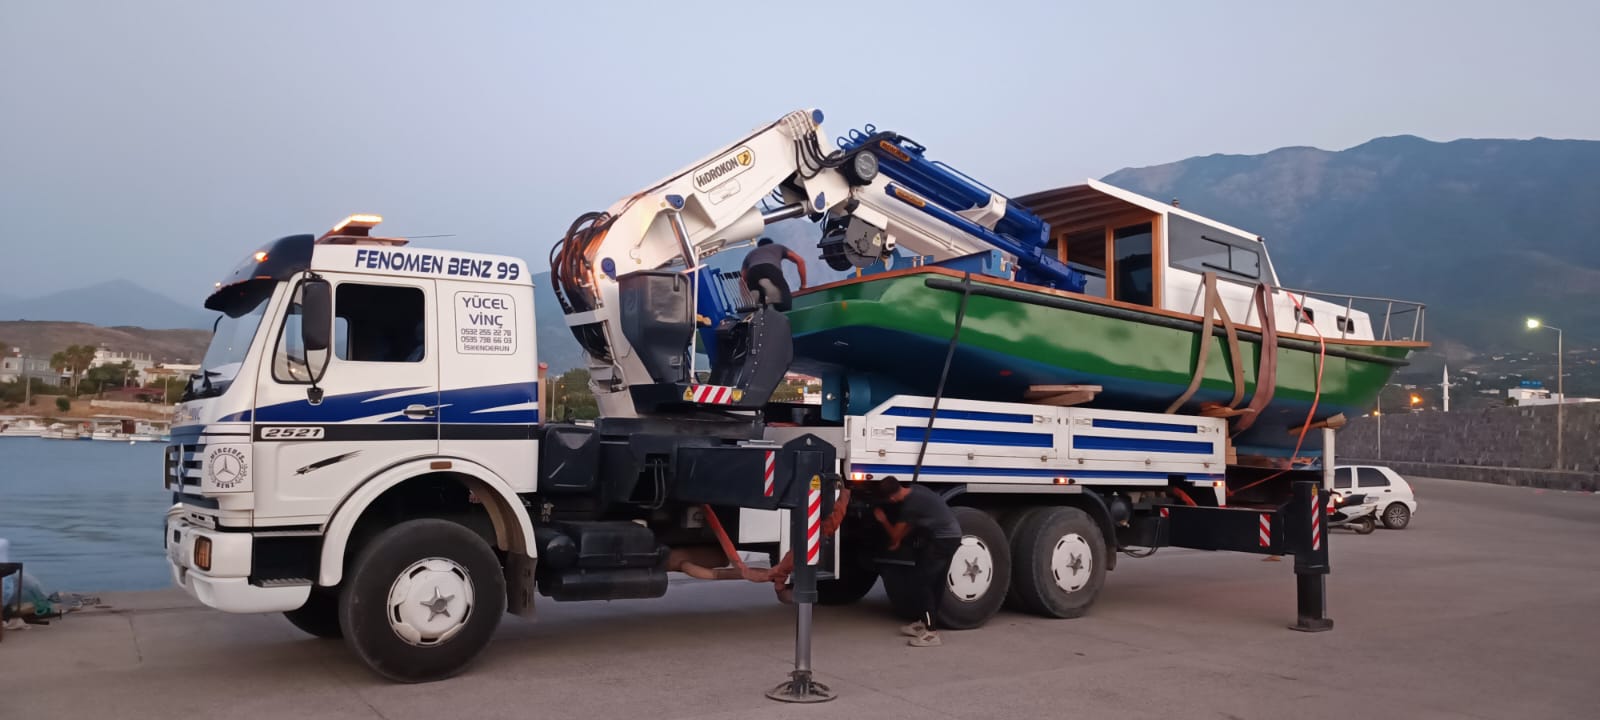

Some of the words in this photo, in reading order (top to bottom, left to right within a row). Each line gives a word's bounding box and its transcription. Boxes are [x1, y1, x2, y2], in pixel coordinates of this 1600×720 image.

[355, 249, 444, 274] FENOMEN
[447, 257, 493, 278] BENZ
[496, 262, 520, 280] 99
[462, 295, 508, 310] YÜCEL
[469, 311, 503, 329] VİNÇ
[264, 428, 322, 438] 2521
